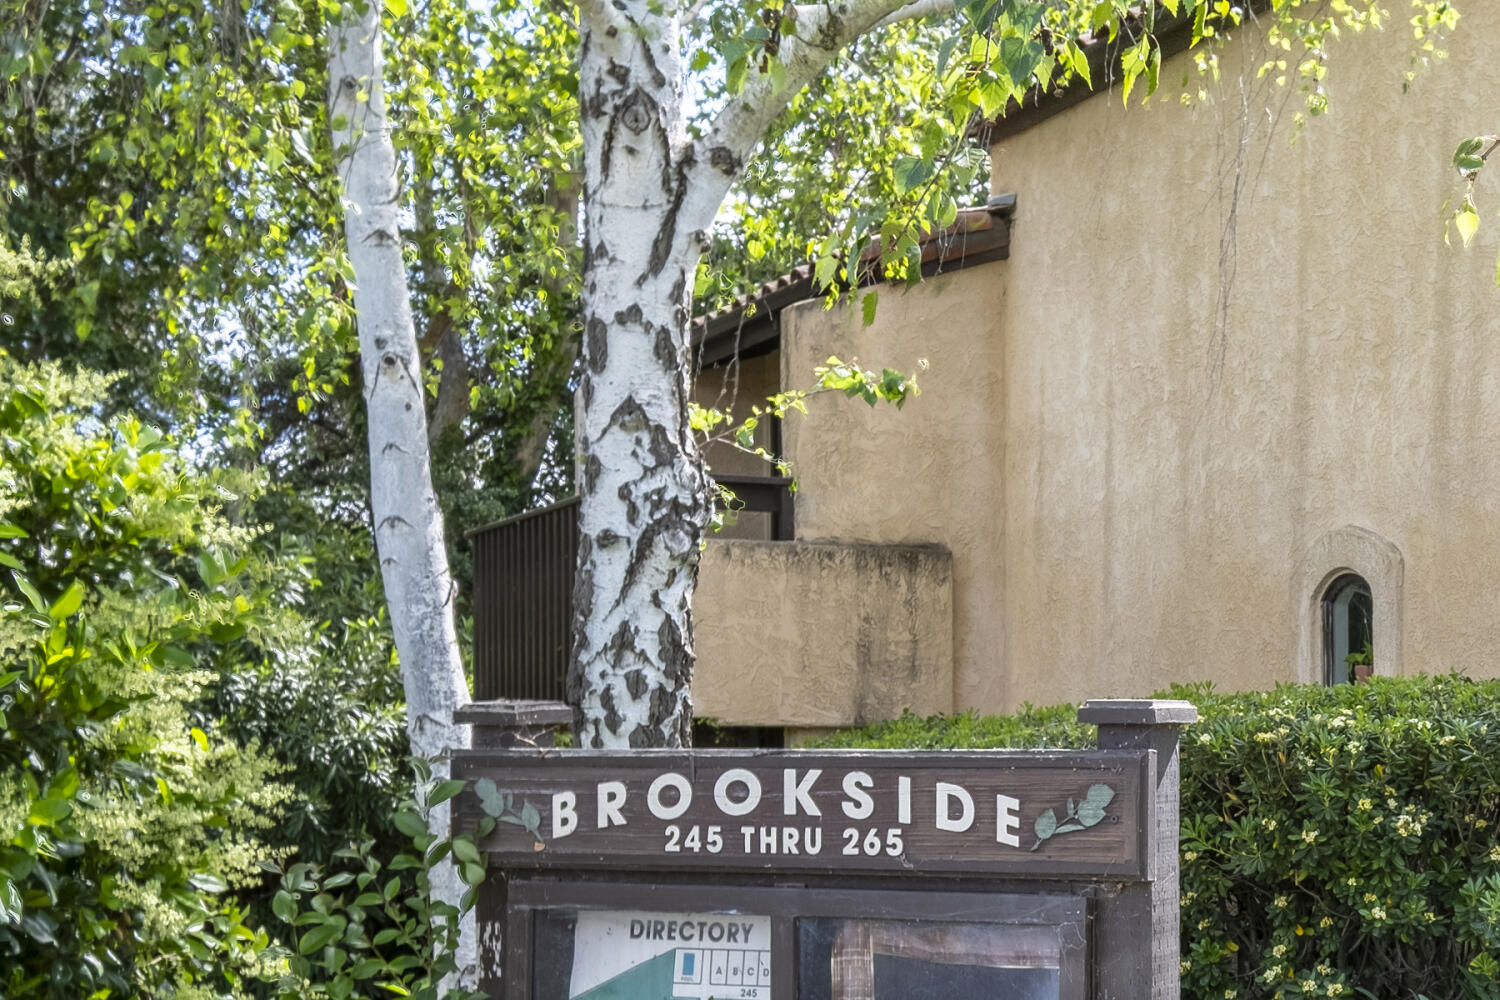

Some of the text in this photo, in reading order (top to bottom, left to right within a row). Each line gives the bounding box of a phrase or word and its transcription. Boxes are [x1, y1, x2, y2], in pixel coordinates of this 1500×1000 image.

[552, 768, 1021, 847] BROOKSIDE
[665, 825, 904, 857] 245 THRU 265
[630, 919, 754, 944] DIRECTORY
[715, 966, 770, 977] A B C D
[740, 988, 758, 998] 245
